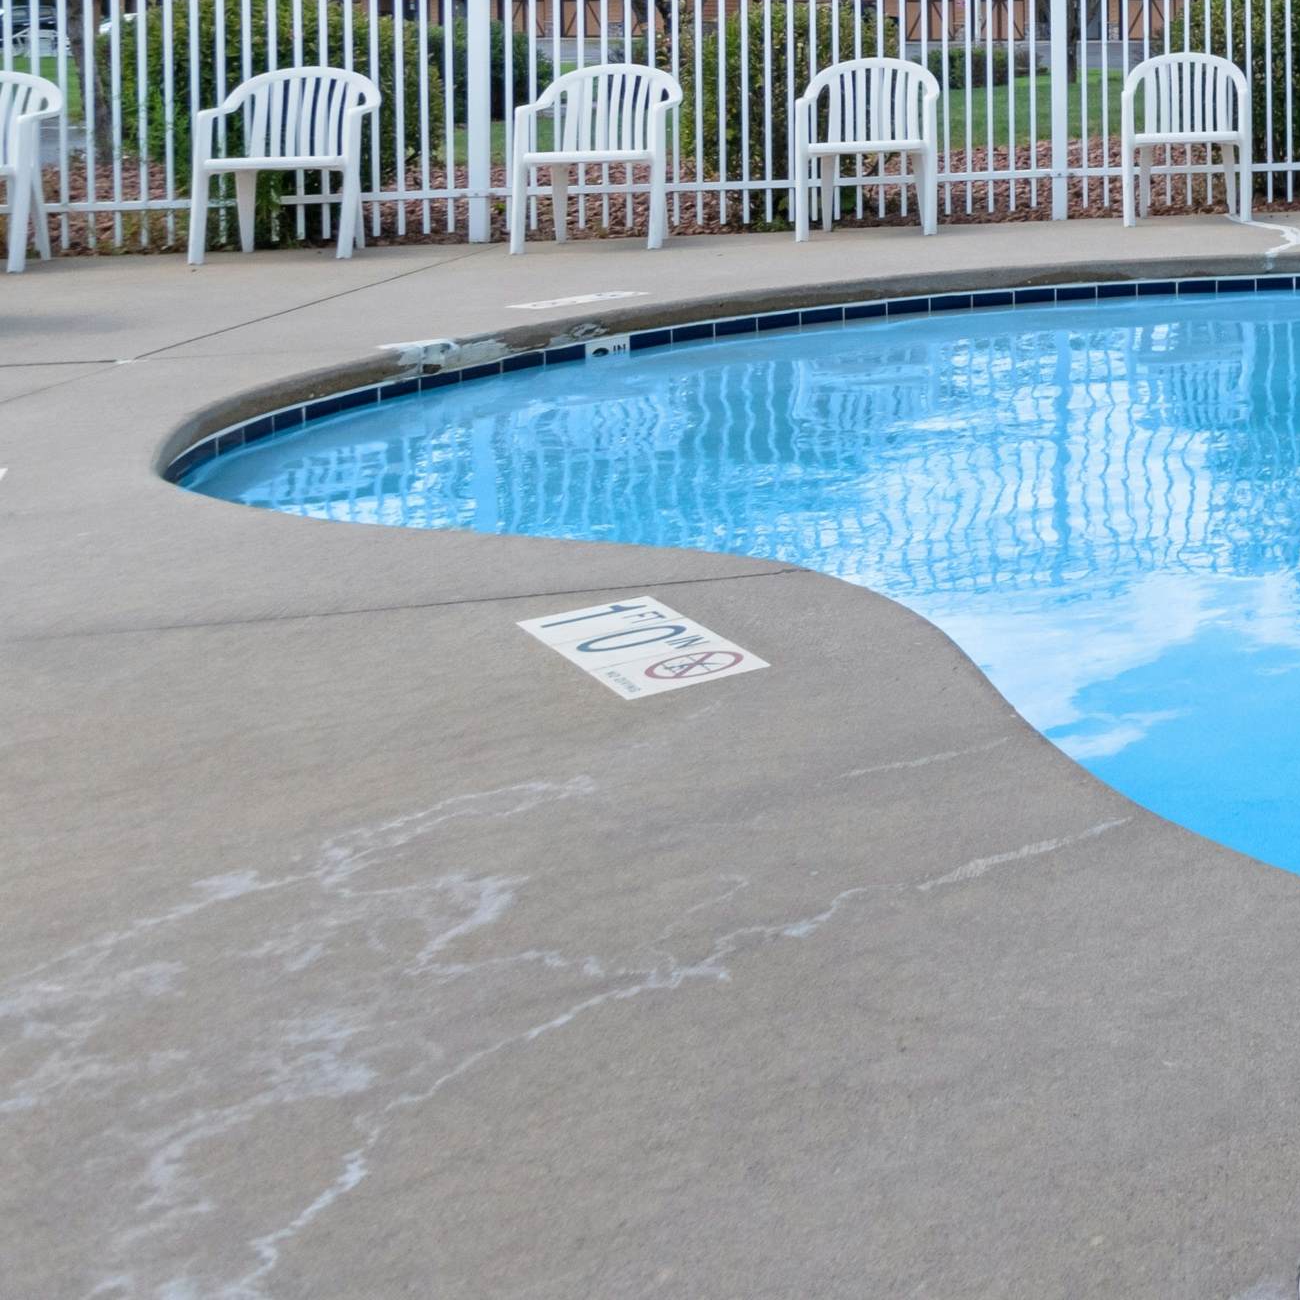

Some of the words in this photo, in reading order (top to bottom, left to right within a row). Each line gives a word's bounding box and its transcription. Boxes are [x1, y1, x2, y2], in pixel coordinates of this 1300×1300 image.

[613, 343, 626, 354] IN
[541, 604, 646, 628] 1
[624, 610, 666, 624] FT
[576, 625, 688, 653] 0
[665, 634, 709, 650] IN
